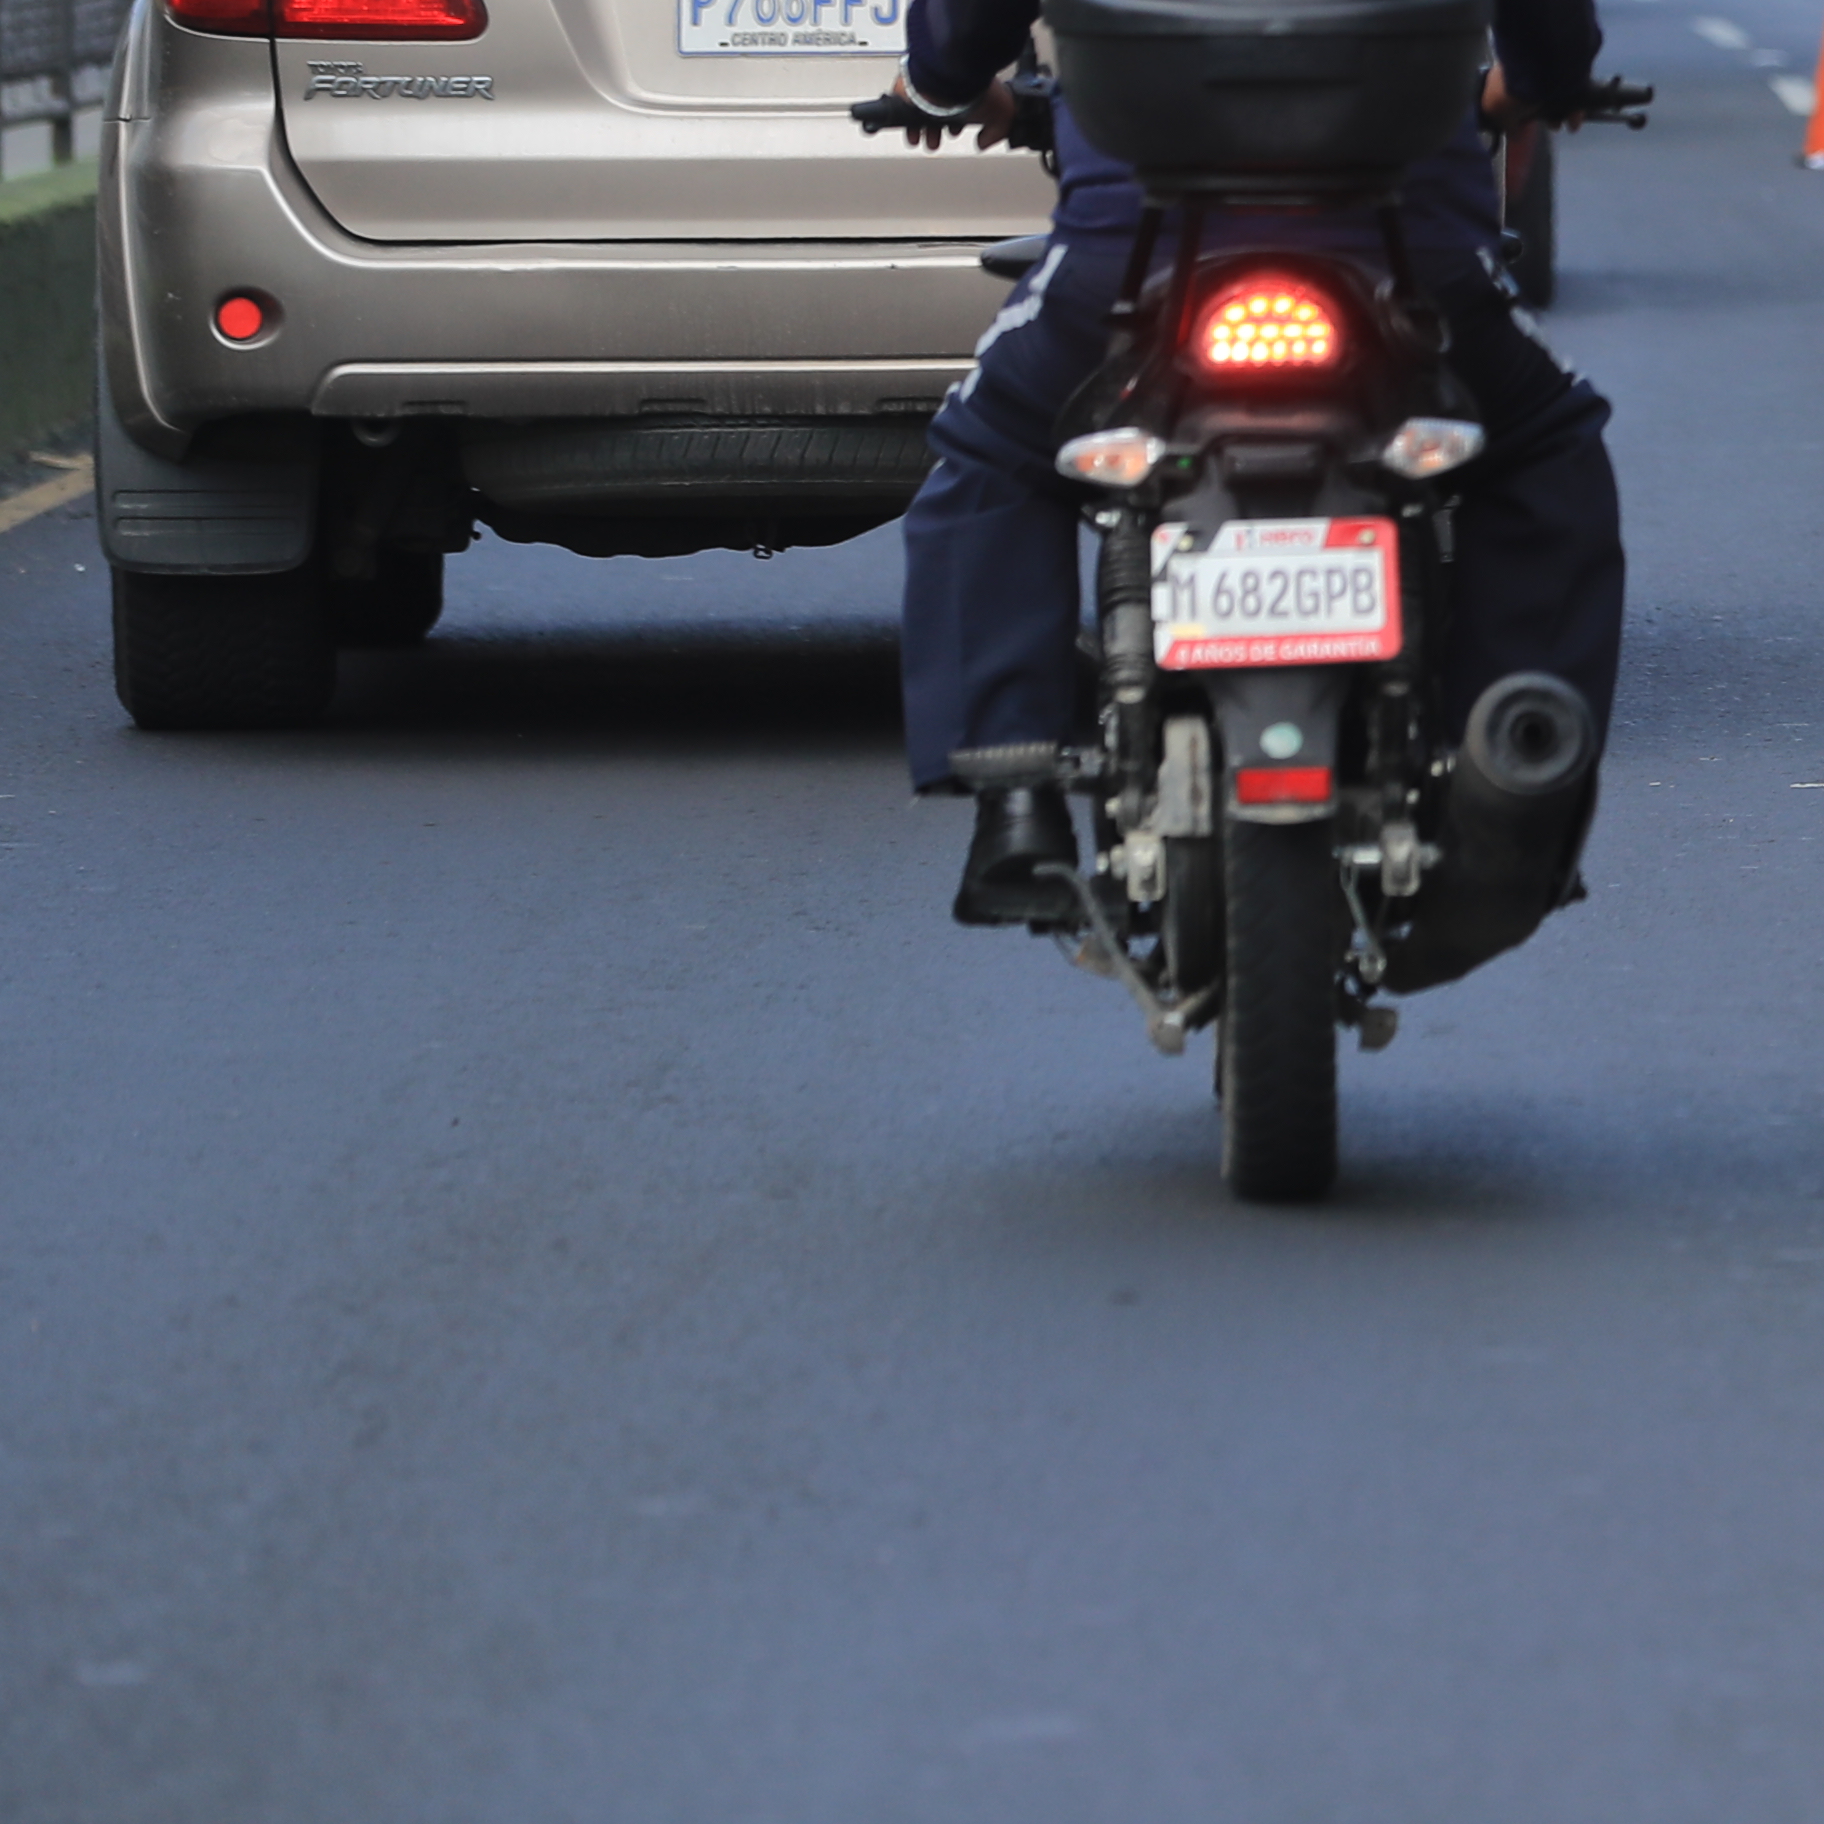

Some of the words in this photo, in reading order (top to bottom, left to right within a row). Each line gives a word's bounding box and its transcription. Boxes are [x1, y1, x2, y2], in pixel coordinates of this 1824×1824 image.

[731, 32, 788, 47] CENTRO
[303, 75, 495, 101] FORTUNER
[1212, 567, 1377, 621] 682GPB
[1250, 640, 1276, 662] DE
